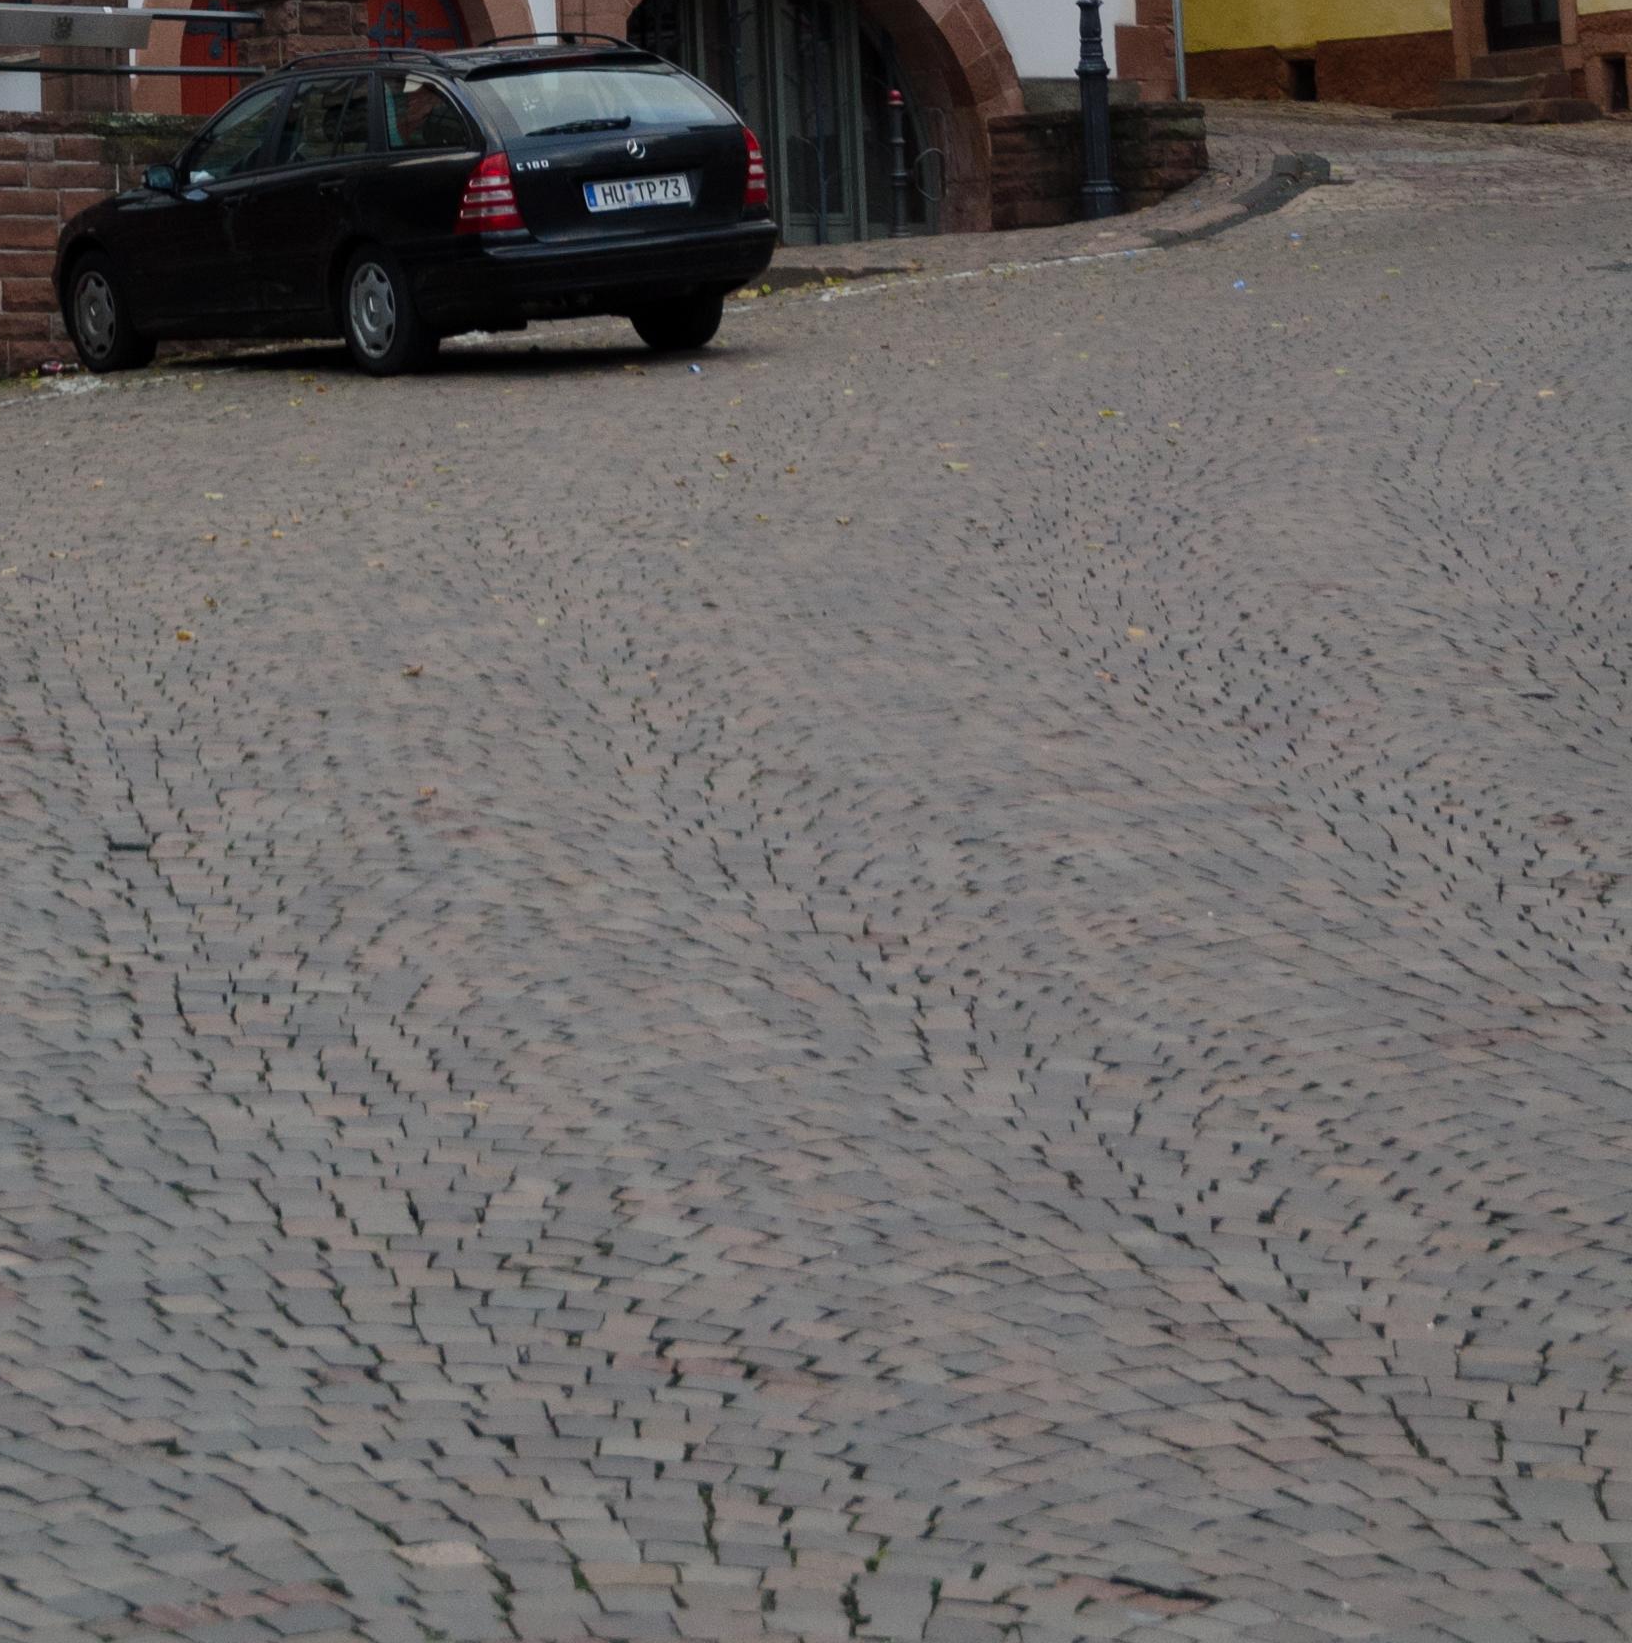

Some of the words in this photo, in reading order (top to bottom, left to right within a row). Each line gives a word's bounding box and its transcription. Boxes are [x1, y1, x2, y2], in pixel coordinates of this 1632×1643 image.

[601, 184, 626, 205] HU
[634, 180, 657, 201] TP
[659, 178, 682, 198] 73
